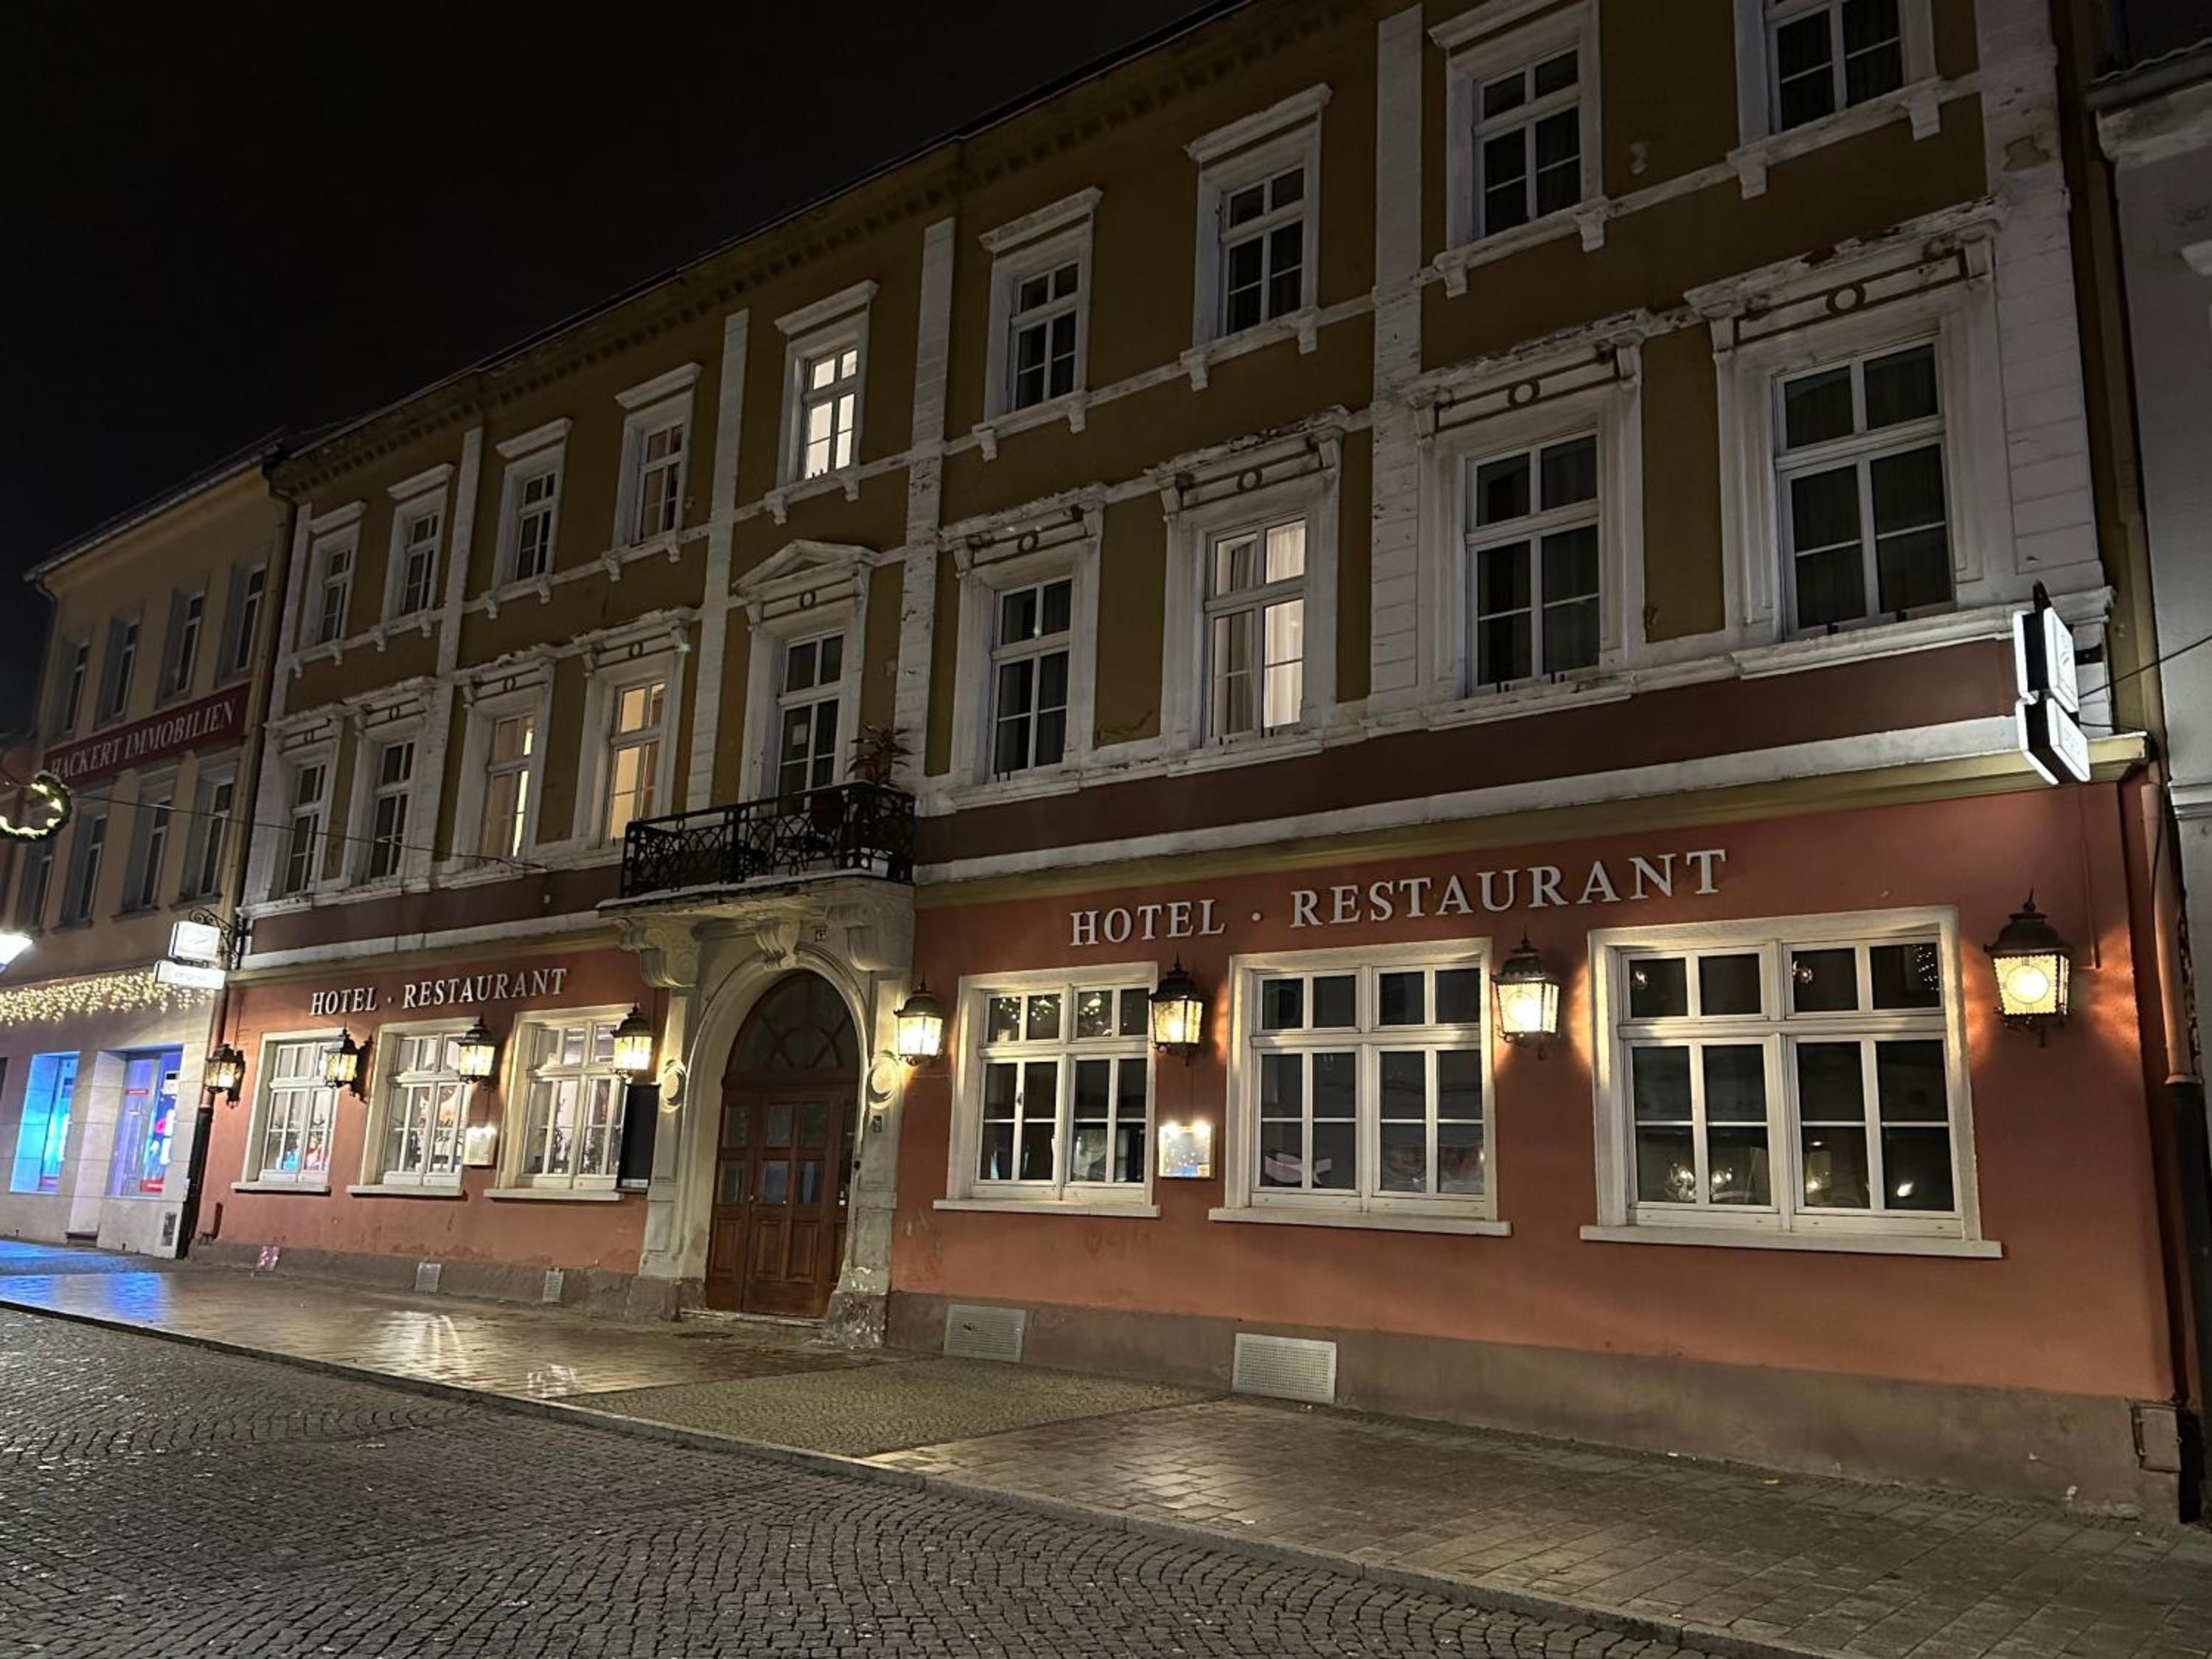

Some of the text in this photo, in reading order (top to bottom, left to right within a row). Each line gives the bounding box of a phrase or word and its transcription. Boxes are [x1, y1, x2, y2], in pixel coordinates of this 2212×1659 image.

[124, 699, 236, 759] IMMOBILIEN
[1070, 849, 1726, 946] HOTEL RESTAURANT
[309, 967, 567, 1016] HOTEL RESTAURANT
